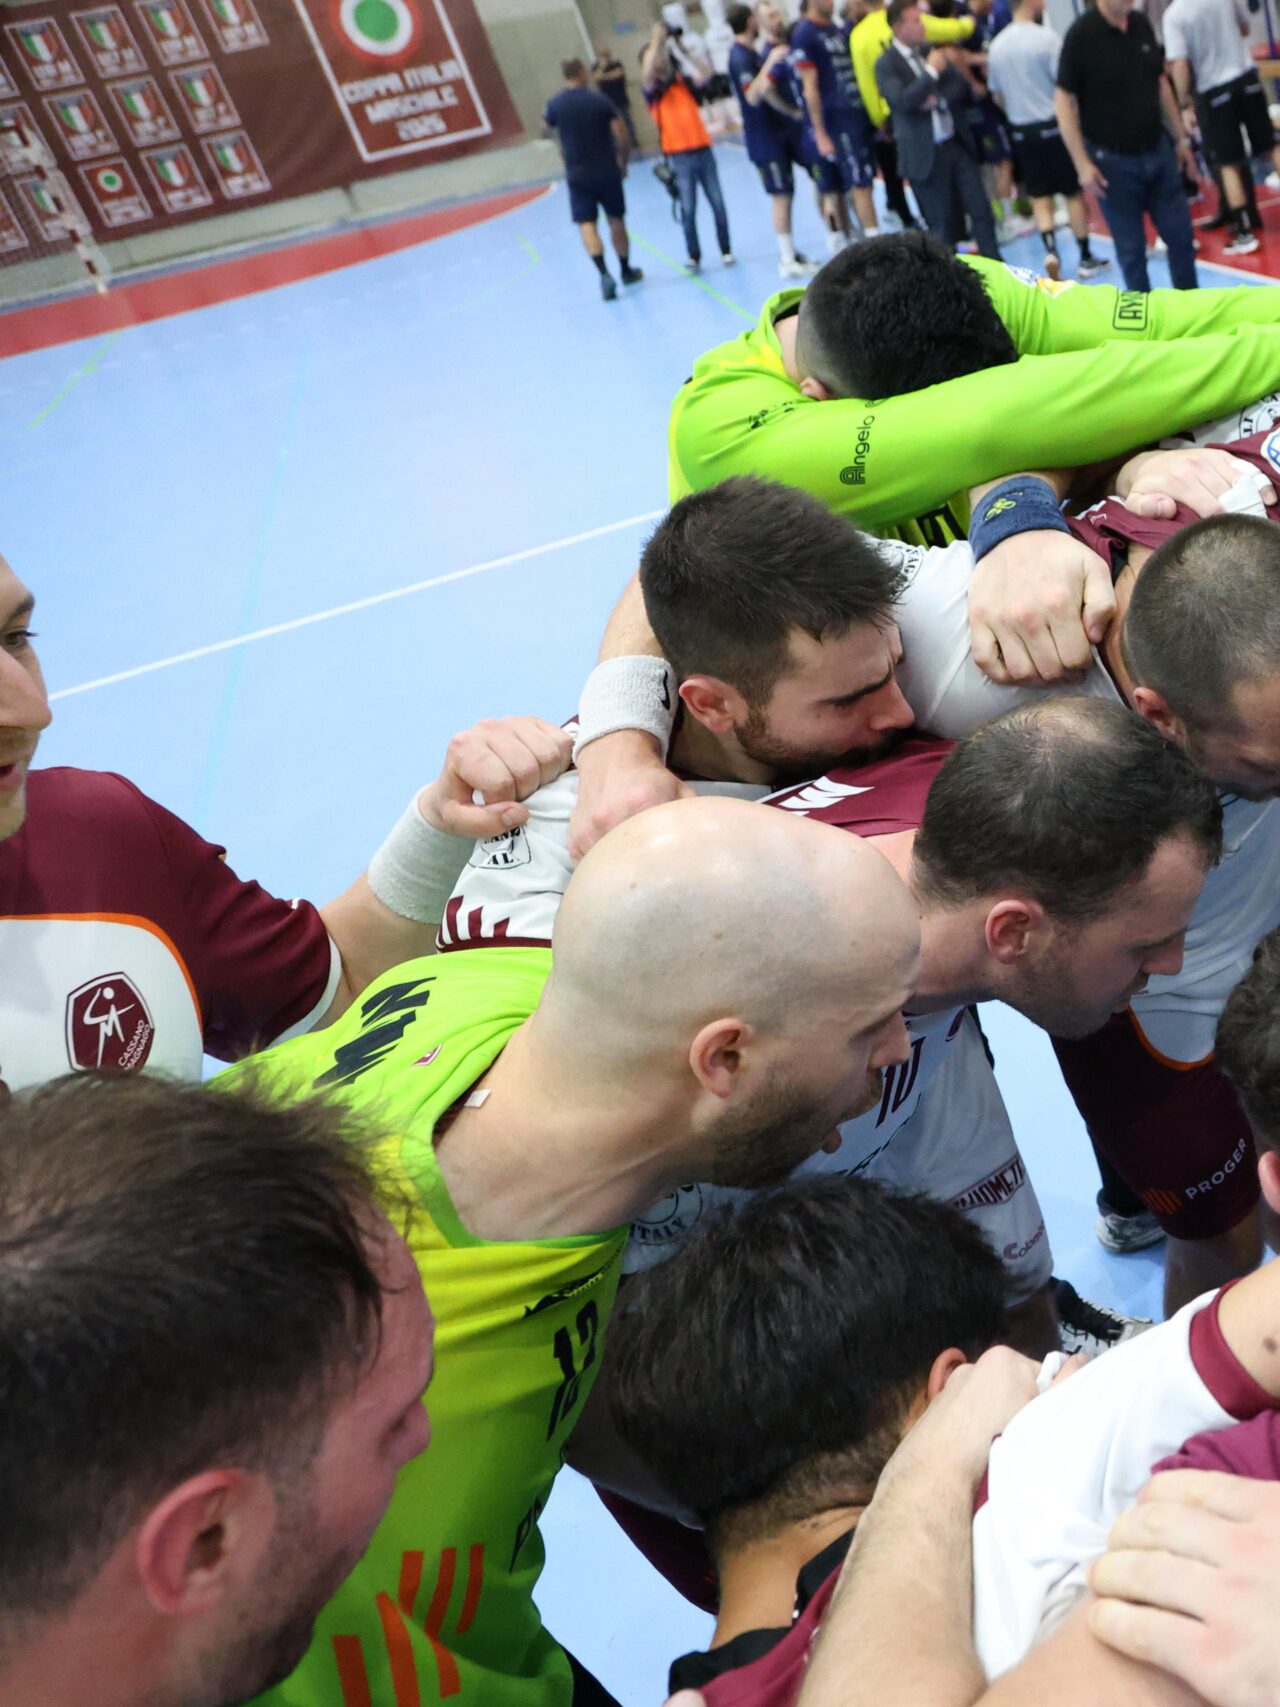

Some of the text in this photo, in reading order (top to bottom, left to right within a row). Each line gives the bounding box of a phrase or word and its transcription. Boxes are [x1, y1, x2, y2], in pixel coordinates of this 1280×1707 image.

[341, 59, 462, 104] COPPA ITALIA
[839, 414, 876, 485] Angelo
[118, 1019, 145, 1066] CASSANO
[1184, 1137, 1248, 1200] PROGER
